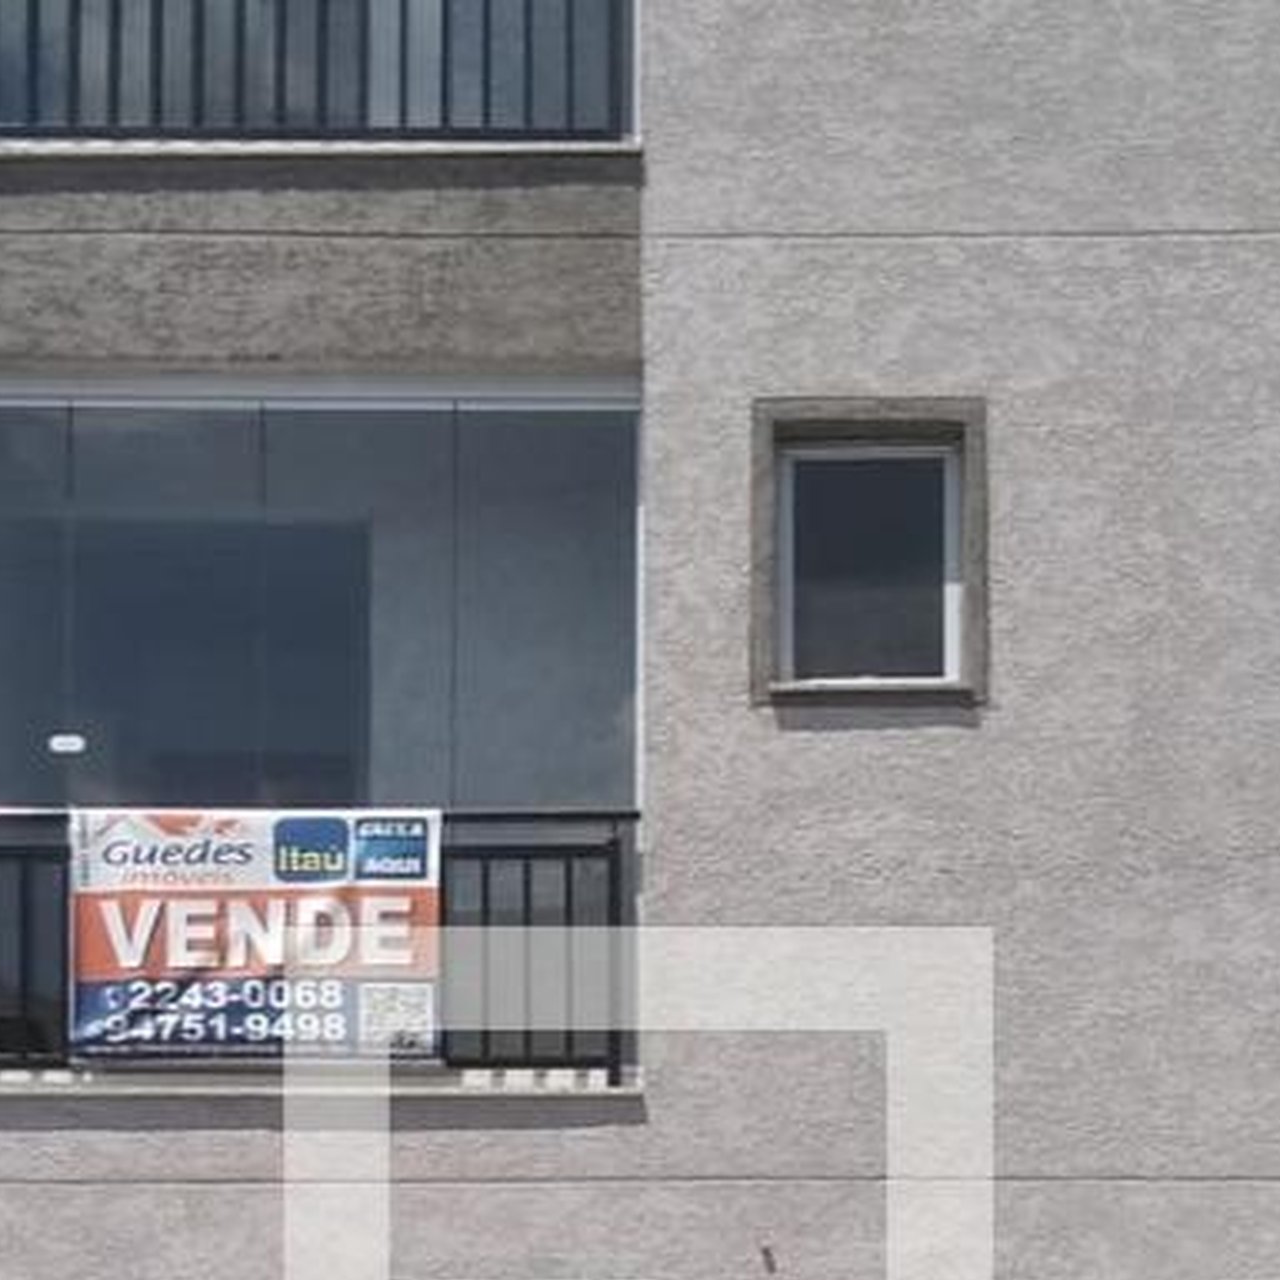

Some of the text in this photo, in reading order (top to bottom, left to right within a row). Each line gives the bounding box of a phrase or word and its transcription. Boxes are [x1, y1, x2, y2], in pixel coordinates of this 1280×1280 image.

[101, 839, 255, 866] Guedes
[278, 845, 345, 873] Itaú
[98, 896, 416, 969] VENDE
[128, 979, 345, 1010] 2243-0068
